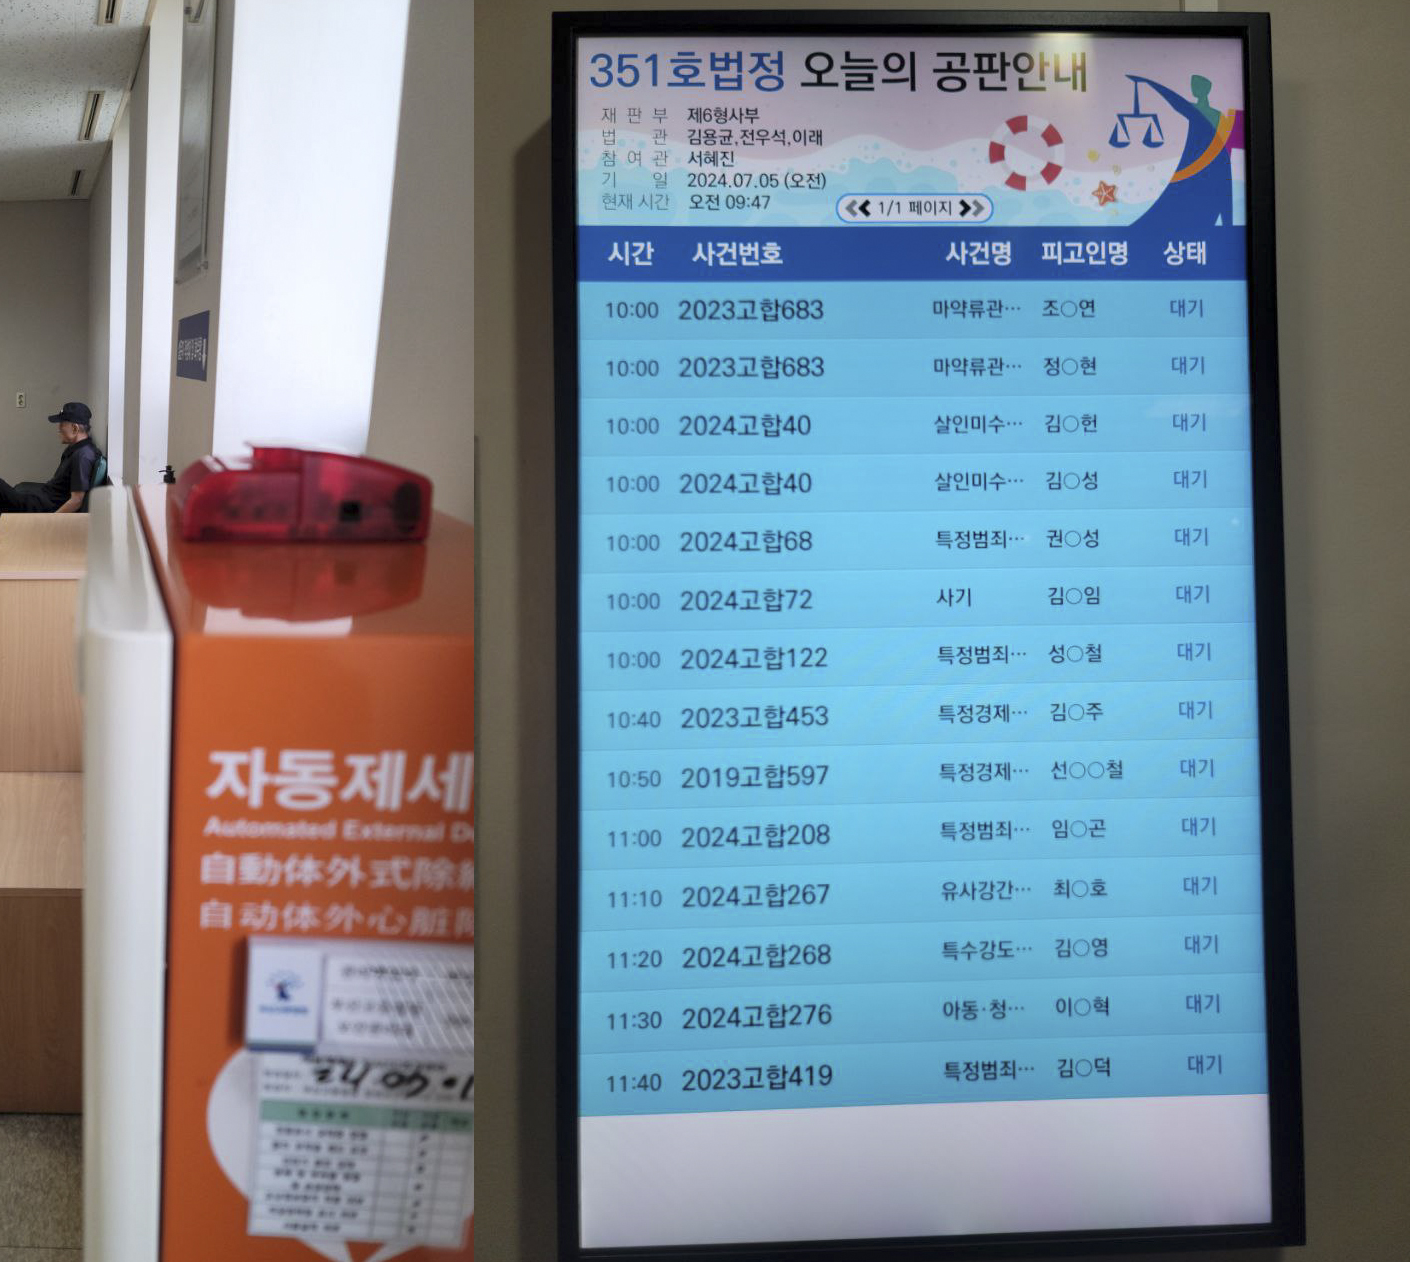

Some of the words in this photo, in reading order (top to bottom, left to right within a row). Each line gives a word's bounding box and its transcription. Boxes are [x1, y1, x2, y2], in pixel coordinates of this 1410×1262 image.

[589, 50, 785, 92] 351호법정
[801, 51, 917, 92] 오늘의
[934, 52, 1087, 92] 공판안내
[687, 106, 760, 125] 제6형사부
[687, 150, 734, 168] 서혜진
[687, 172, 780, 189] 2024.07.05
[784, 172, 827, 190] (오전)
[601, 192, 633, 211] 현재
[637, 192, 670, 211] 시간
[689, 193, 720, 211] 오전
[725, 194, 771, 210] 09:47
[878, 201, 904, 218] 1/1
[908, 201, 954, 218] 페이지
[607, 241, 655, 267] 시간
[691, 239, 784, 267] 사건번호
[945, 239, 1012, 266] 사건명
[1041, 240, 1129, 266] 피고인명
[1163, 240, 1207, 266] 상태
[605, 301, 660, 319] 10:00
[678, 298, 824, 323] 2023고합683
[1169, 298, 1204, 319] 대기
[606, 359, 660, 378] 10:00
[679, 355, 825, 380] 2023고합683
[1171, 355, 1205, 376] 대기
[606, 416, 660, 436] 10:00
[679, 414, 812, 438] 2024고합40
[1172, 412, 1206, 432] 대기
[607, 474, 661, 493] 10:00
[679, 471, 813, 496] 2024고합40
[1173, 469, 1207, 490] 대기
[606, 533, 661, 552] 10:00
[680, 529, 813, 554] 2024고합68
[1174, 527, 1209, 547] 대기
[607, 592, 661, 611] 10:00
[680, 588, 813, 613] 2024고합72
[936, 587, 972, 608] 사기
[1175, 584, 1210, 605] 대기
[607, 650, 662, 670] 10:00
[681, 646, 828, 671] 2024고합122
[1176, 641, 1212, 662] 대기
[607, 710, 662, 729] 10:40
[681, 704, 829, 730] 2023고합453
[1178, 700, 1213, 720] 대기
[205, 747, 474, 813] 자동제세
[607, 769, 662, 789] 10:50
[681, 764, 830, 789] 2019고합597
[1179, 758, 1215, 779] 대기
[203, 816, 336, 840] Automated
[343, 819, 444, 842] External
[607, 829, 663, 848] 11:00
[681, 823, 831, 849] 2024고합208
[1181, 816, 1216, 837] 대기
[608, 889, 663, 909] 11:10
[682, 883, 830, 909] 2024고합267
[1182, 875, 1218, 896] 대기
[607, 949, 663, 970] 11:20
[682, 943, 832, 969] 2024고합268
[1184, 934, 1219, 955] 대기
[607, 1010, 663, 1031] 11:30
[682, 1003, 833, 1030] 2024고합276
[1185, 993, 1221, 1014] 대기
[606, 1072, 662, 1093] 11:40
[681, 1063, 833, 1092] 2023고합419
[1187, 1054, 1223, 1075] 대기
